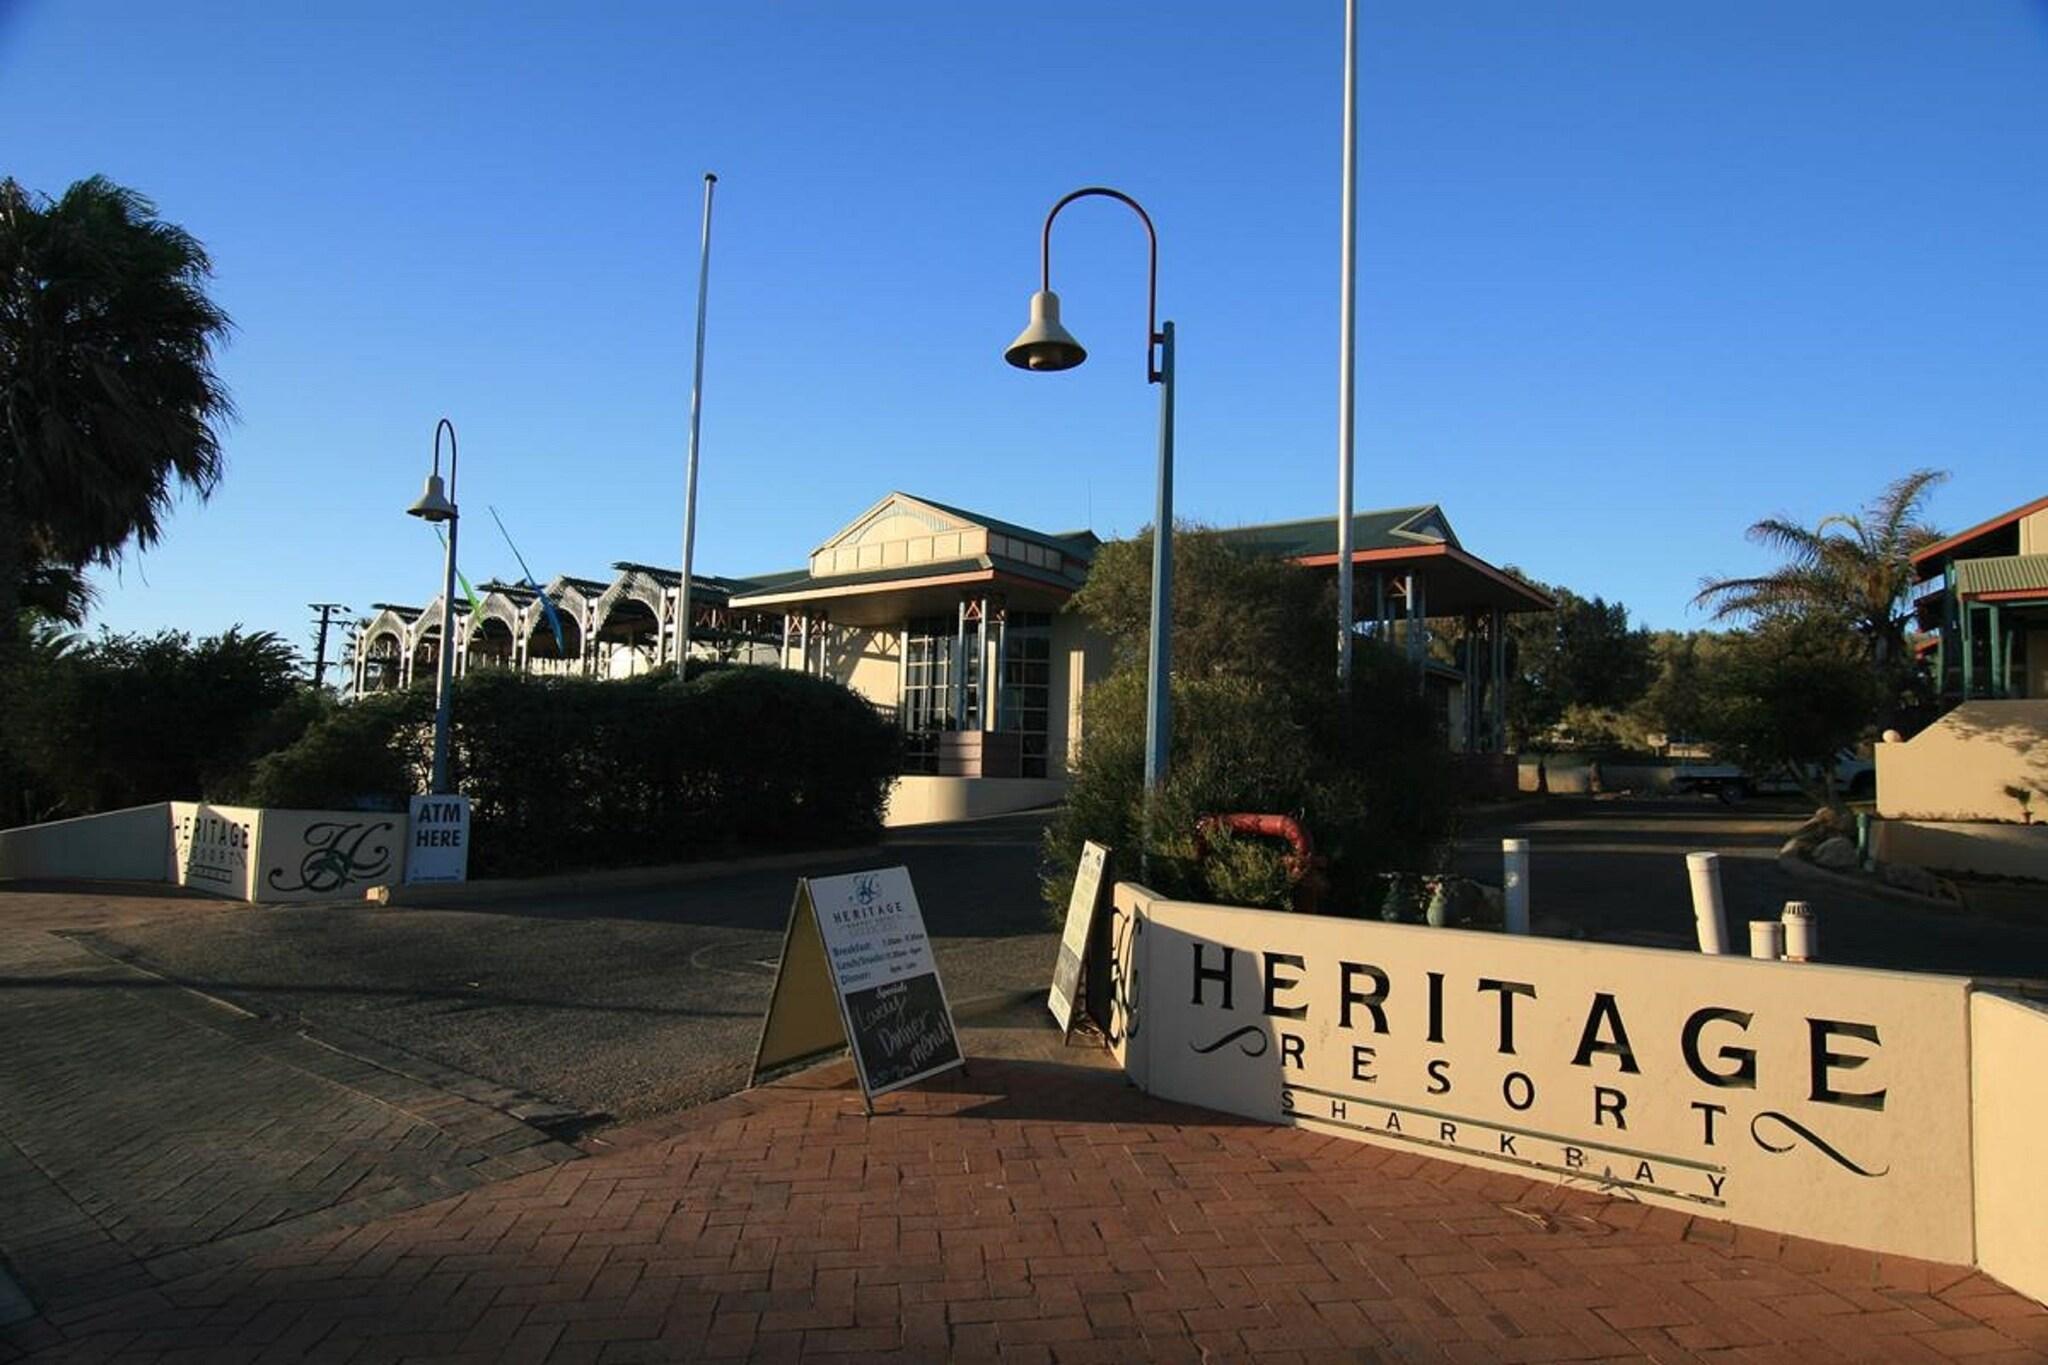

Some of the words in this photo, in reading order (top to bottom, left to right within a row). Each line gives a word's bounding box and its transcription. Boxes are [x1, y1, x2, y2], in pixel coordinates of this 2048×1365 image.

[418, 803, 461, 823] ATM
[416, 829, 462, 847] HERE
[832, 901, 903, 923] HERITAGE
[1189, 942, 1888, 1112] HERITAGE
[1281, 1032, 1727, 1146] RESORT
